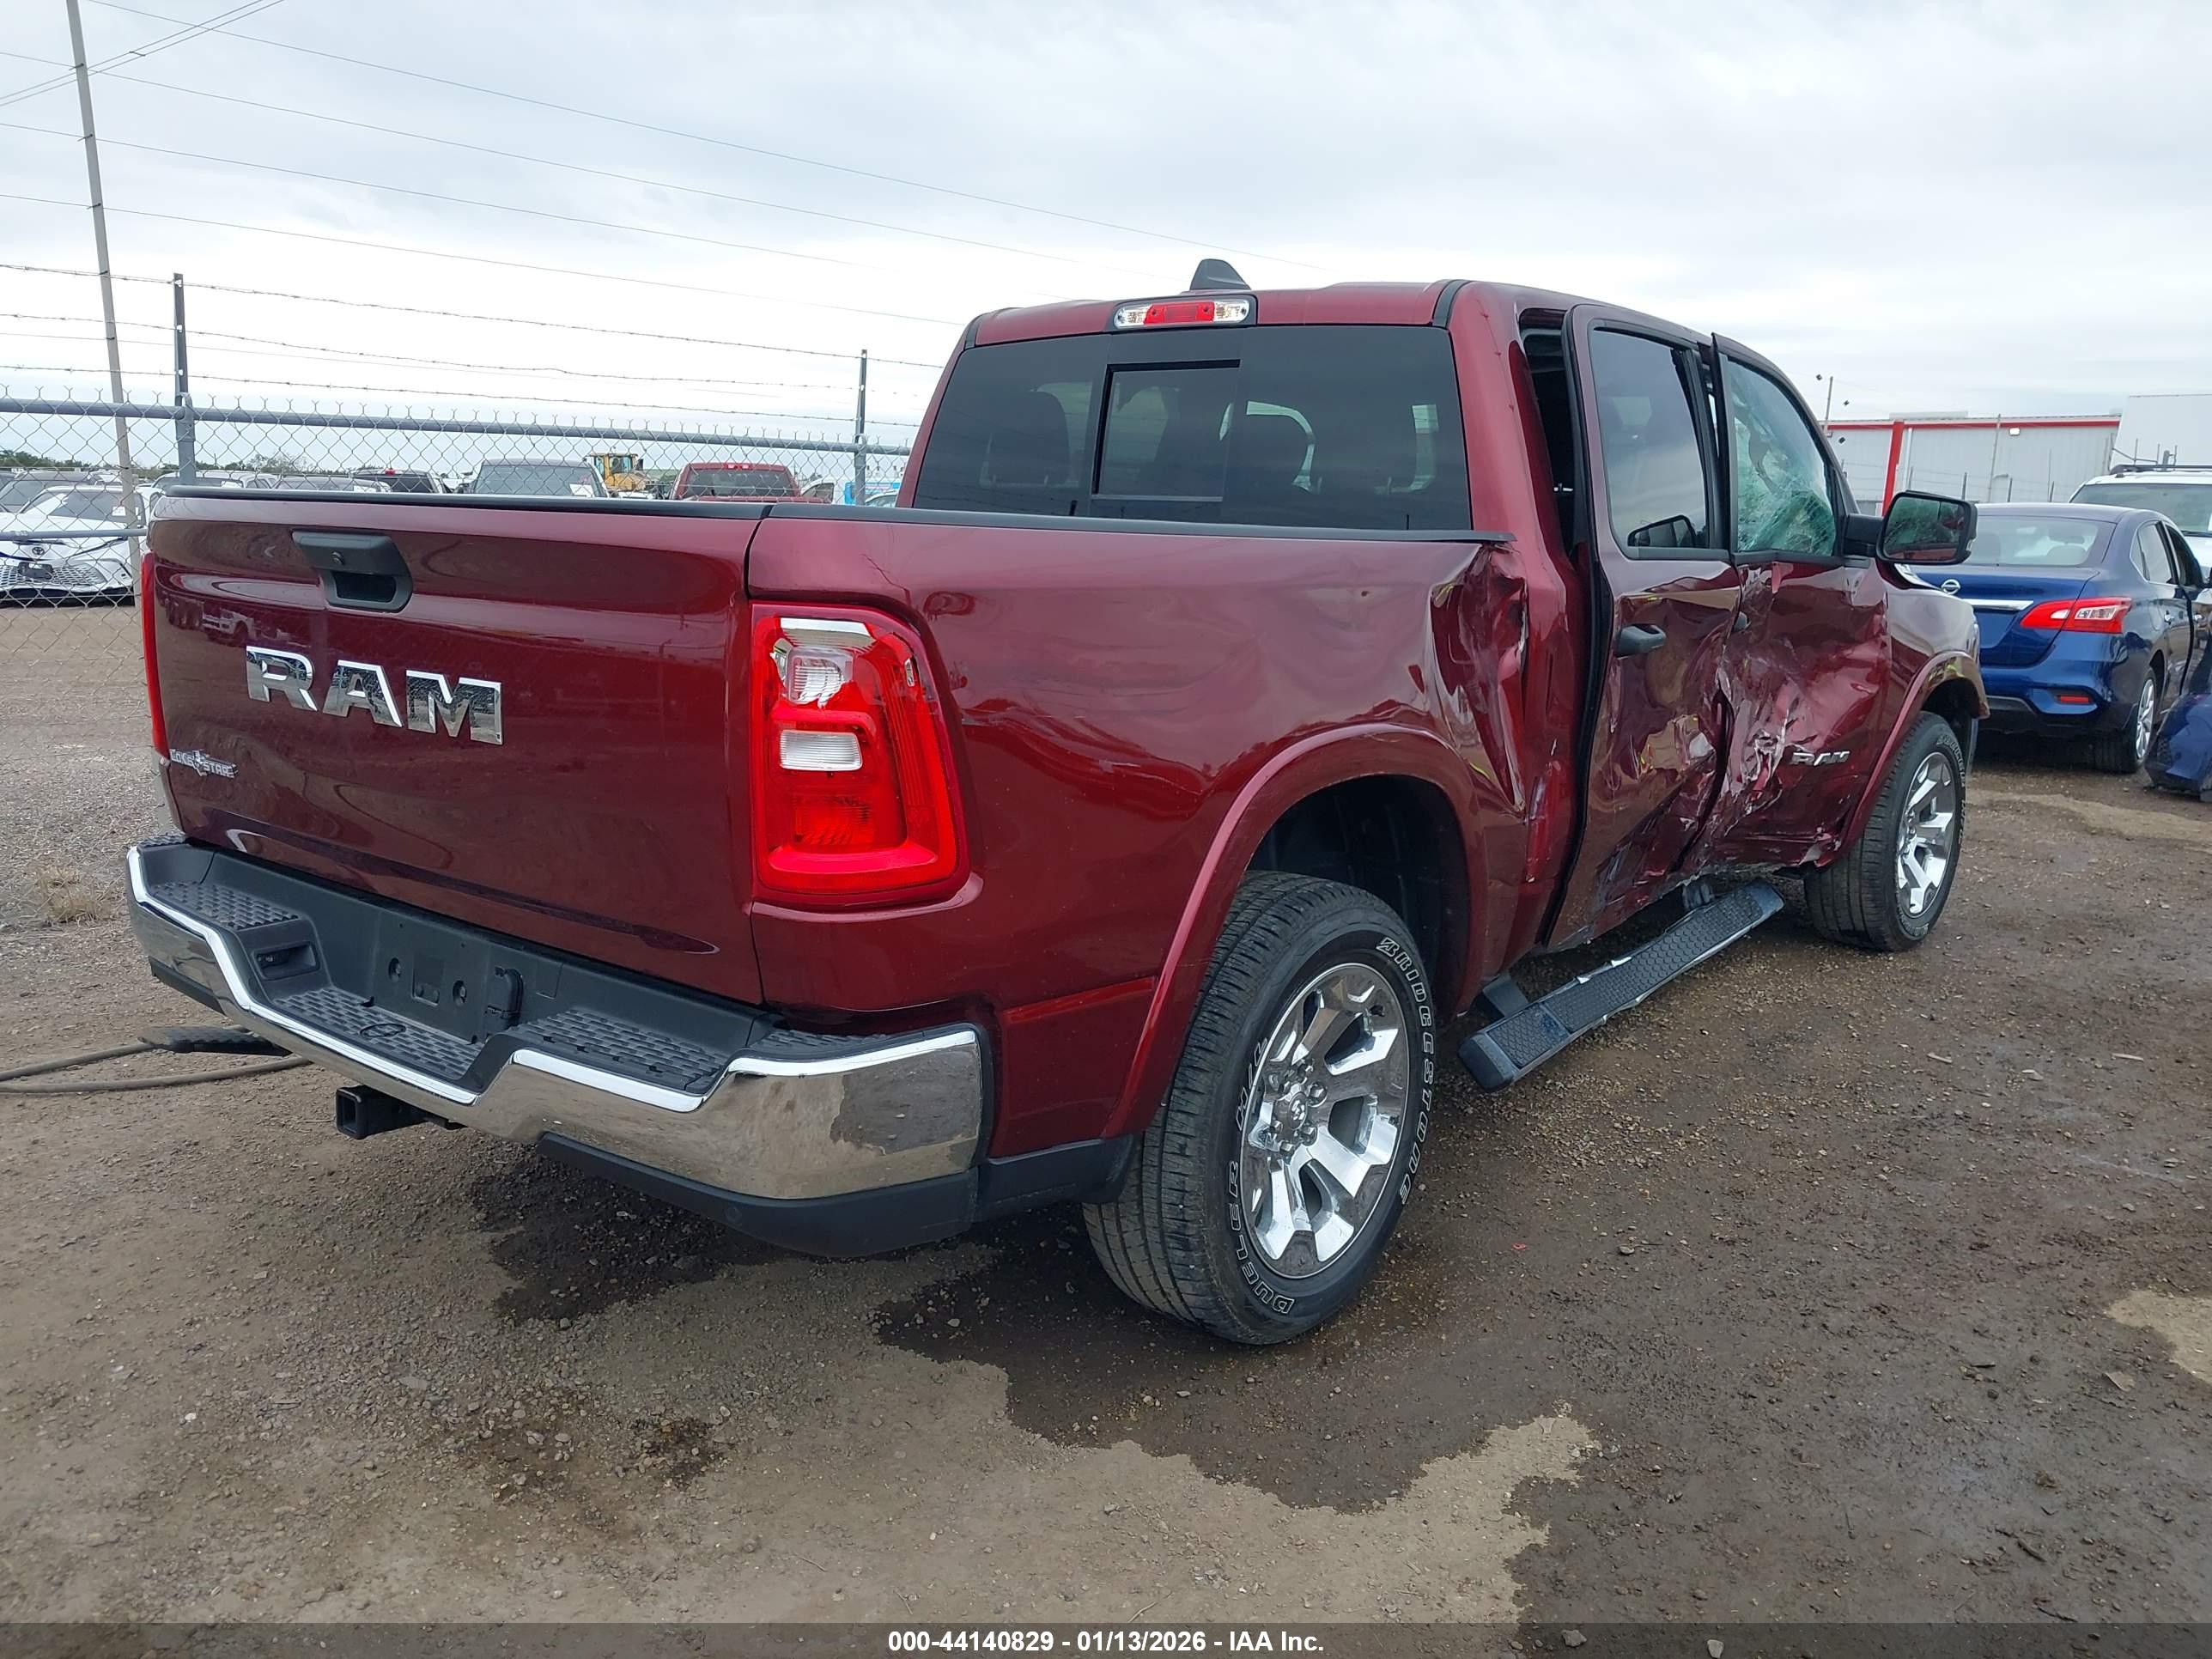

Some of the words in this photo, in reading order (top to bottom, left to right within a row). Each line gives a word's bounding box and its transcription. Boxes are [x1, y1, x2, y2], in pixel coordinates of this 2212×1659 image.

[246, 645, 504, 745] RAM
[203, 760, 231, 777] STAR
[1790, 750, 1850, 767] RAM
[1376, 937, 1434, 1204] BRIDGESTONE
[1229, 1160, 1296, 1315] DUELER
